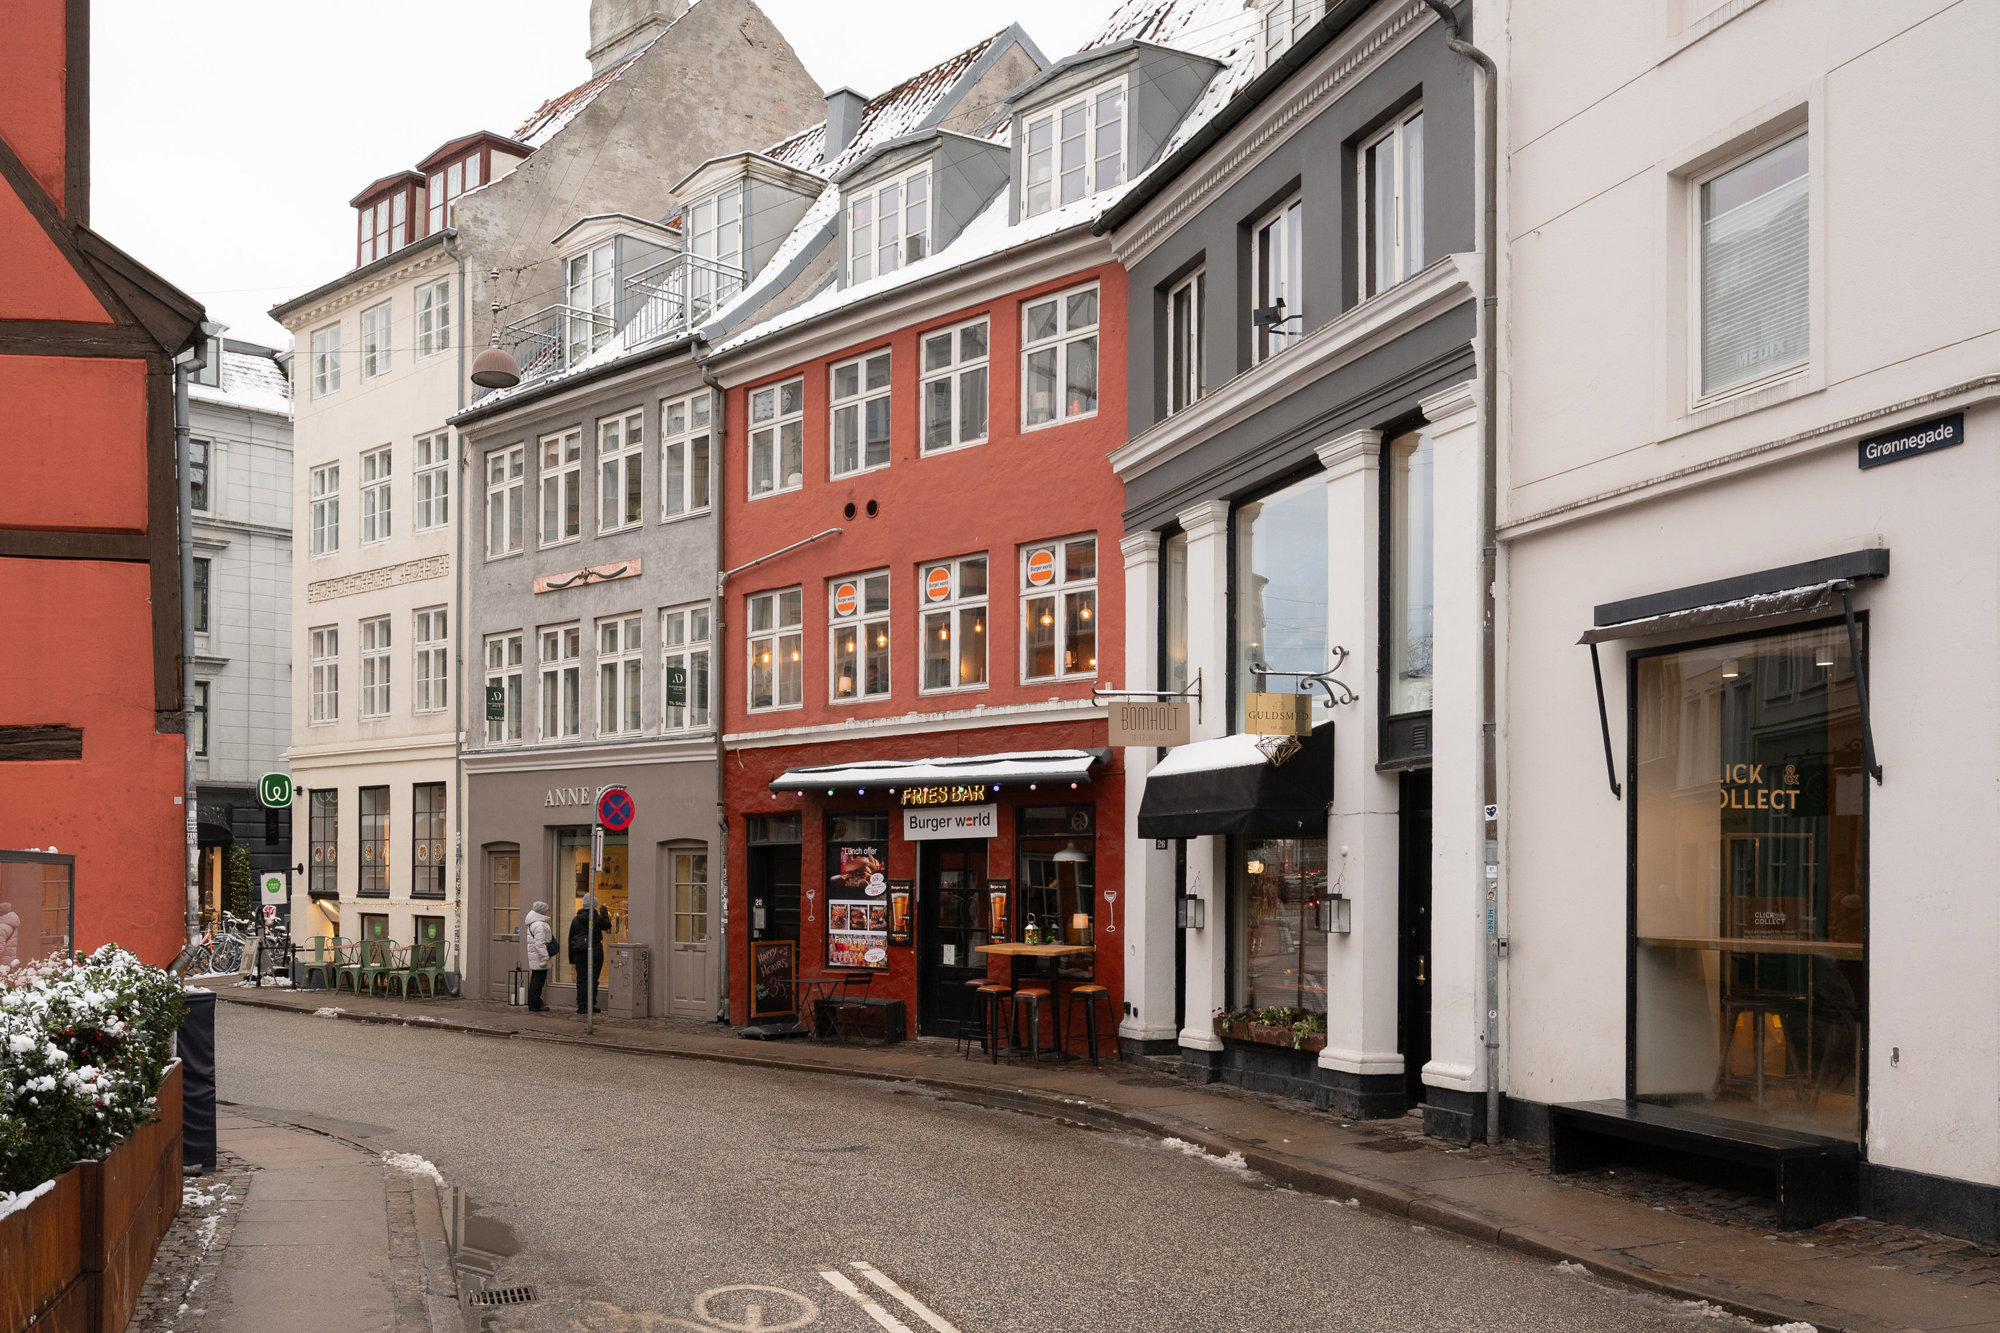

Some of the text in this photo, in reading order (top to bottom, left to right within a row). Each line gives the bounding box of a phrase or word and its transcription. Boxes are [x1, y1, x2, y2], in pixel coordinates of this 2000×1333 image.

[1736, 338, 1784, 368] MEDIX
[1866, 424, 1953, 459] Grønnegade
[1121, 706, 1179, 731] BOMHOLT
[1248, 710, 1309, 720] GULDSMED
[1720, 764, 1800, 785] ICK &
[544, 786, 590, 806] ANNE
[901, 785, 985, 805] FRIES BAR
[909, 816, 952, 832] Burger
[1157, 840, 1166, 848] 26
